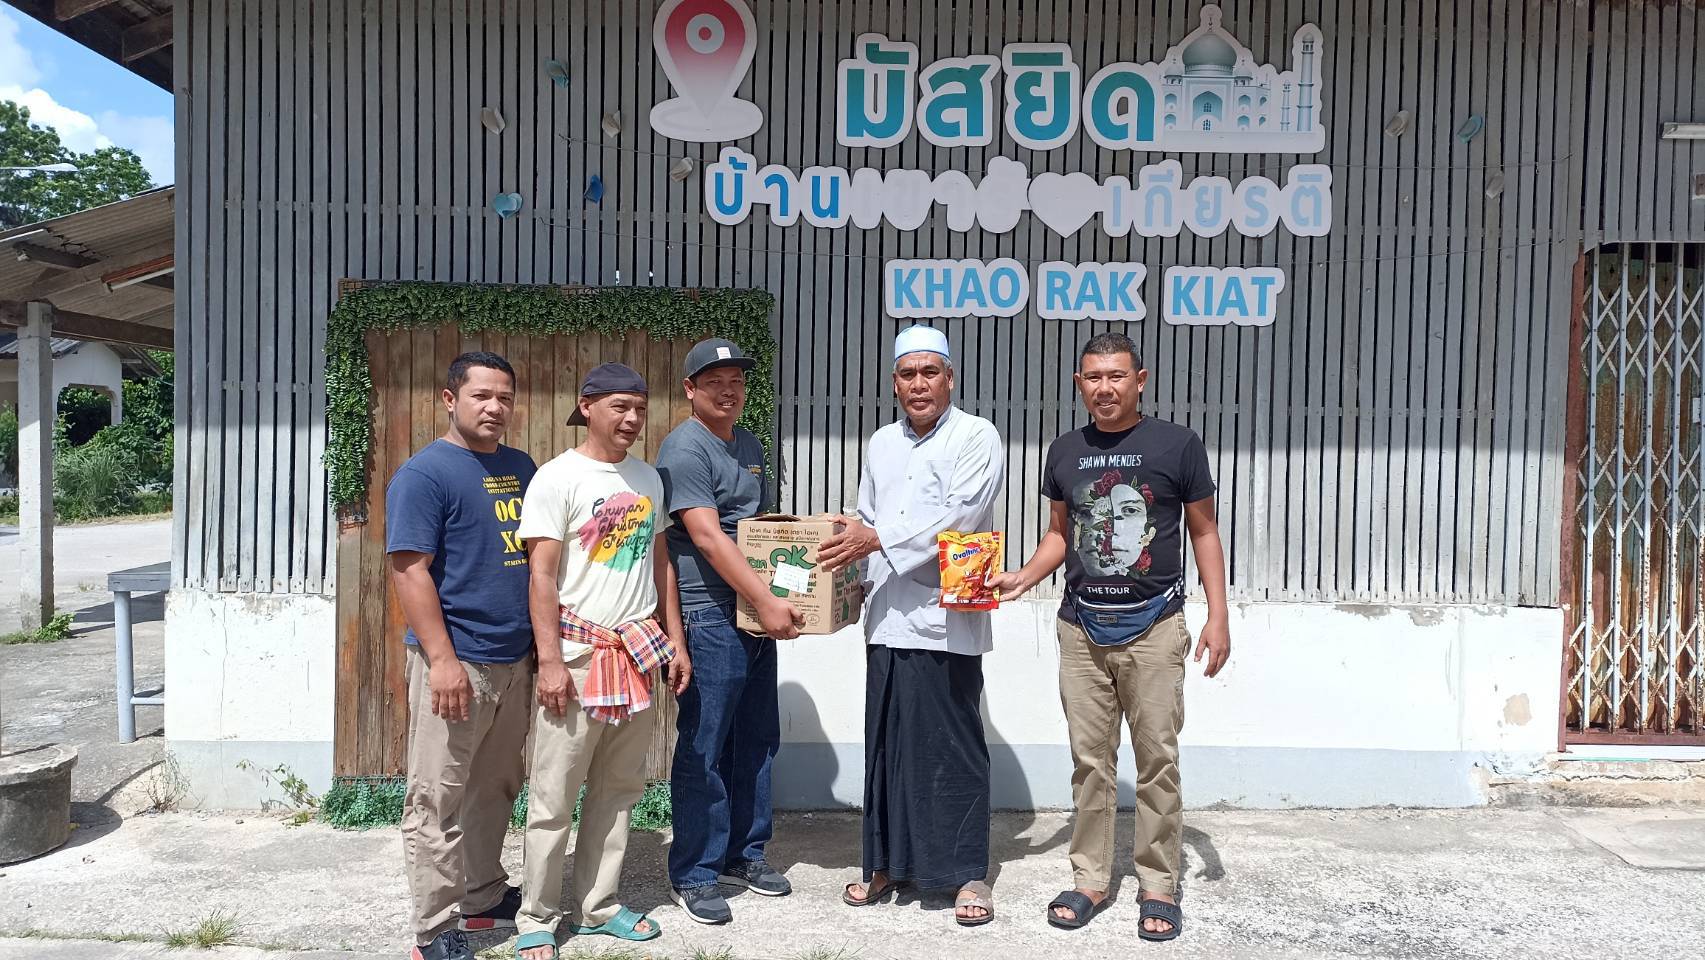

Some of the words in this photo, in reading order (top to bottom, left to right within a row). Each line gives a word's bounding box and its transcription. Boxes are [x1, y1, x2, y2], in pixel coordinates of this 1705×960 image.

[846, 42, 1155, 142] มัสยิด
[894, 267, 1021, 309] KHAO
[1045, 270, 1137, 312] RAK
[1172, 274, 1276, 317] KIAT
[1078, 455, 1106, 470] SHAWN
[1108, 454, 1143, 467] MENDES
[592, 497, 645, 520] Cruzan
[770, 544, 818, 570] OK
[952, 546, 981, 561] Ovaltine
[1086, 586, 1104, 595] THE
[1104, 586, 1131, 595] TOUR
